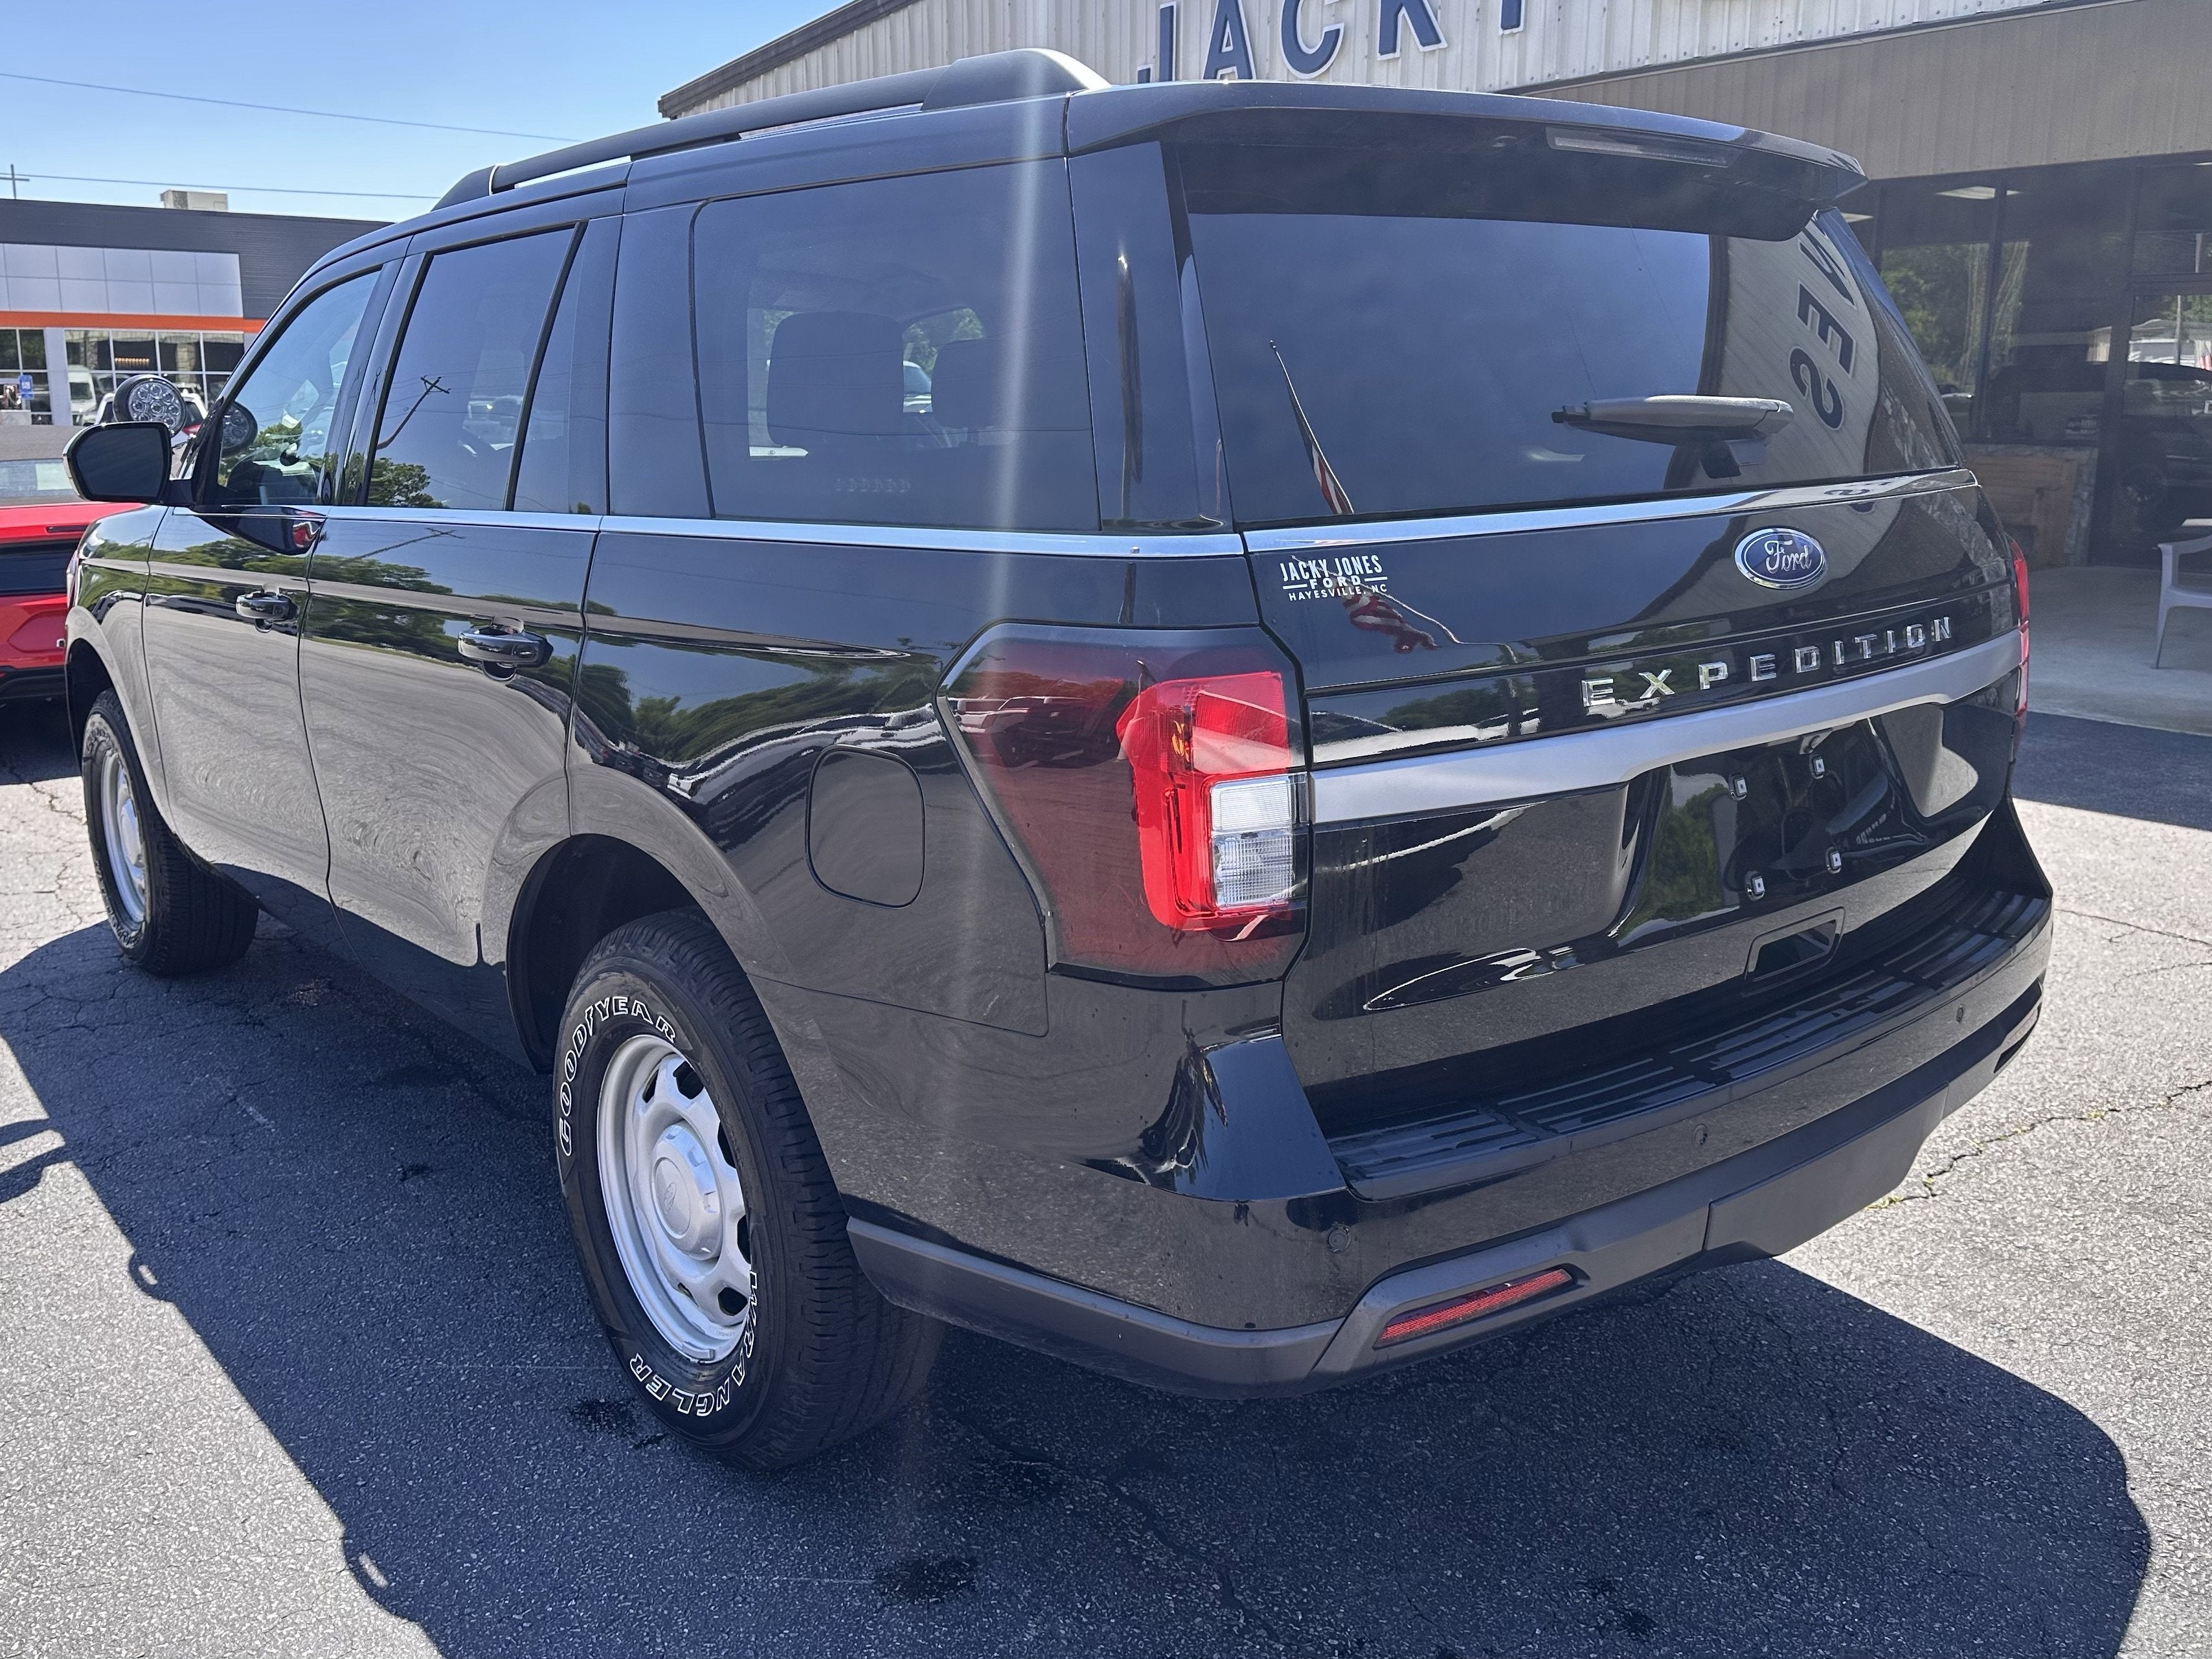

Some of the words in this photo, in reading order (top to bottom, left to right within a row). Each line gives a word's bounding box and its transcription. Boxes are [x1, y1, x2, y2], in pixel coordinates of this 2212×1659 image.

[1280, 559, 1329, 582] JACKY
[1334, 554, 1383, 577] JONES
[1763, 539, 1812, 574] Ford
[1309, 575, 1362, 590] FORD
[1371, 583, 1388, 594] NC
[1581, 616, 1952, 708] EXPEDITION
[559, 995, 676, 1157] GOODYEAR
[629, 1269, 758, 1417] WRANGLER
